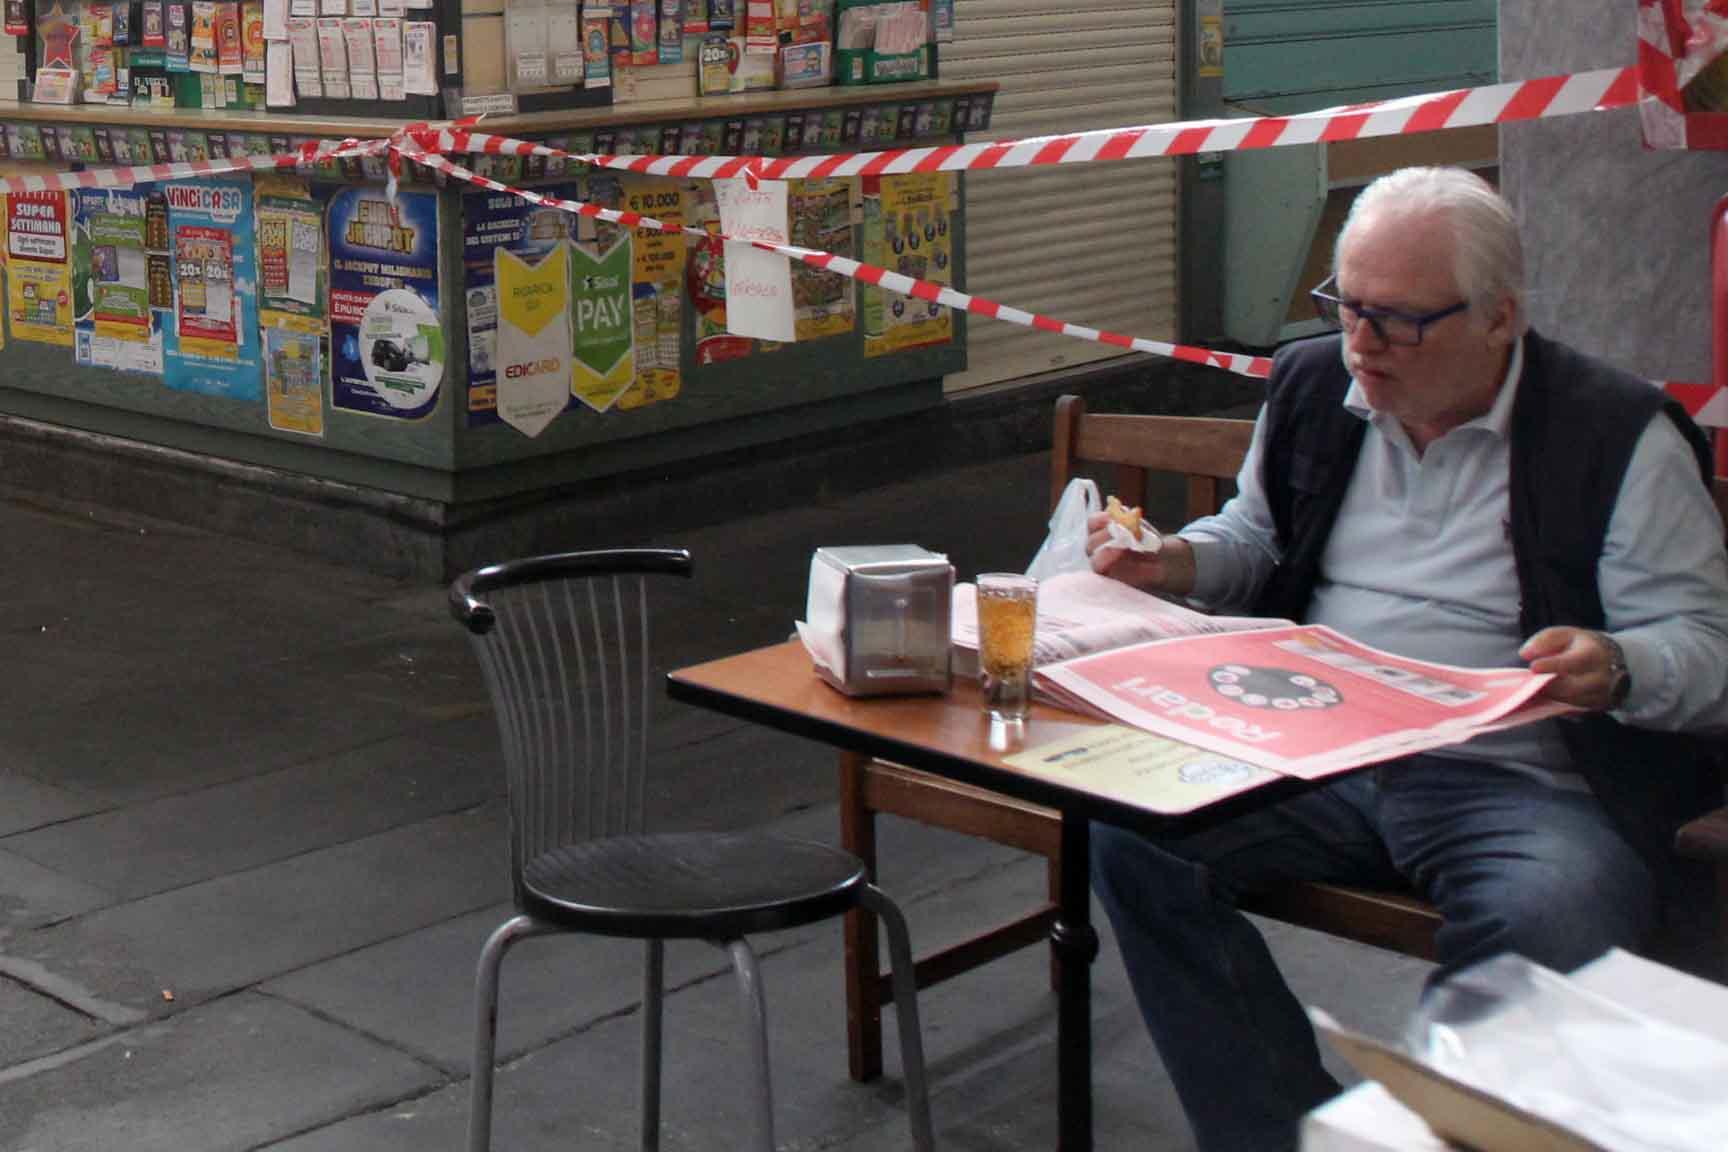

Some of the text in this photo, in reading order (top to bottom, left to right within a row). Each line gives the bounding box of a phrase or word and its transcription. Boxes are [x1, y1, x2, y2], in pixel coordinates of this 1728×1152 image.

[203, 190, 241, 211] CASA
[642, 192, 680, 208] 10.000
[16, 203, 56, 218] SUPER
[11, 218, 62, 234] SETTIMANA
[345, 221, 416, 254] JACKPOT
[577, 295, 625, 333] PAY
